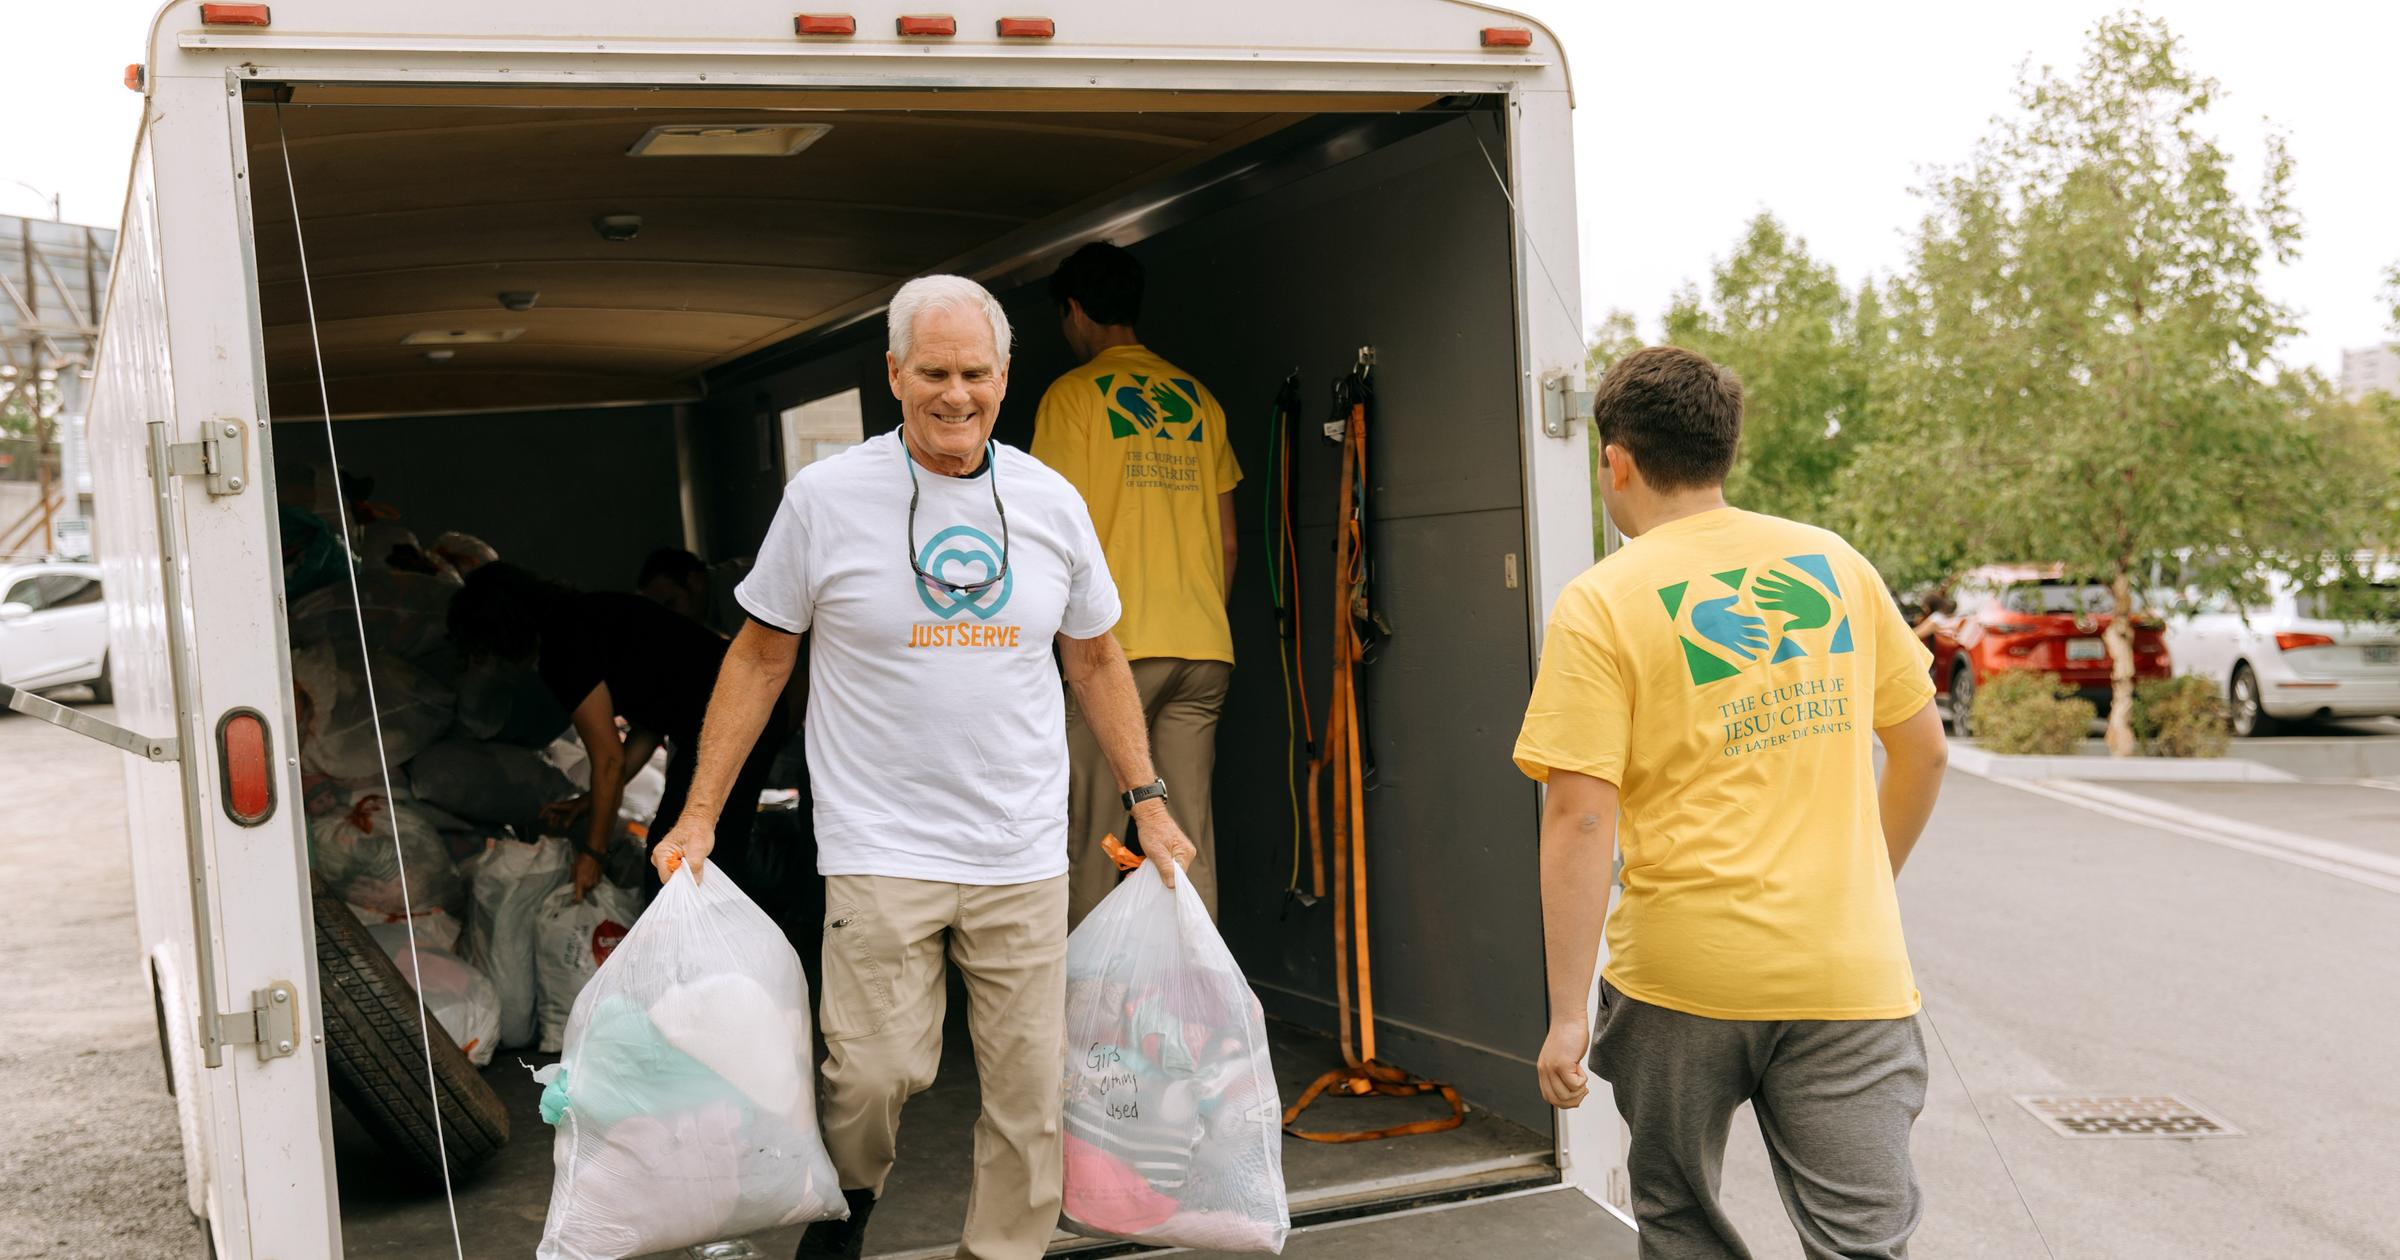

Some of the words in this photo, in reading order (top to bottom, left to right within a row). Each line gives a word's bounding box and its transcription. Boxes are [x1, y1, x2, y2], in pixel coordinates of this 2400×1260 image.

[908, 622, 1021, 648] JUSTSERVE
[1718, 696, 1755, 718] THE
[1725, 745, 1741, 757] OF
[1745, 728, 1809, 753] LATER-DY
[1812, 721, 1852, 735] SANTS
[1106, 1101, 1138, 1120] used
